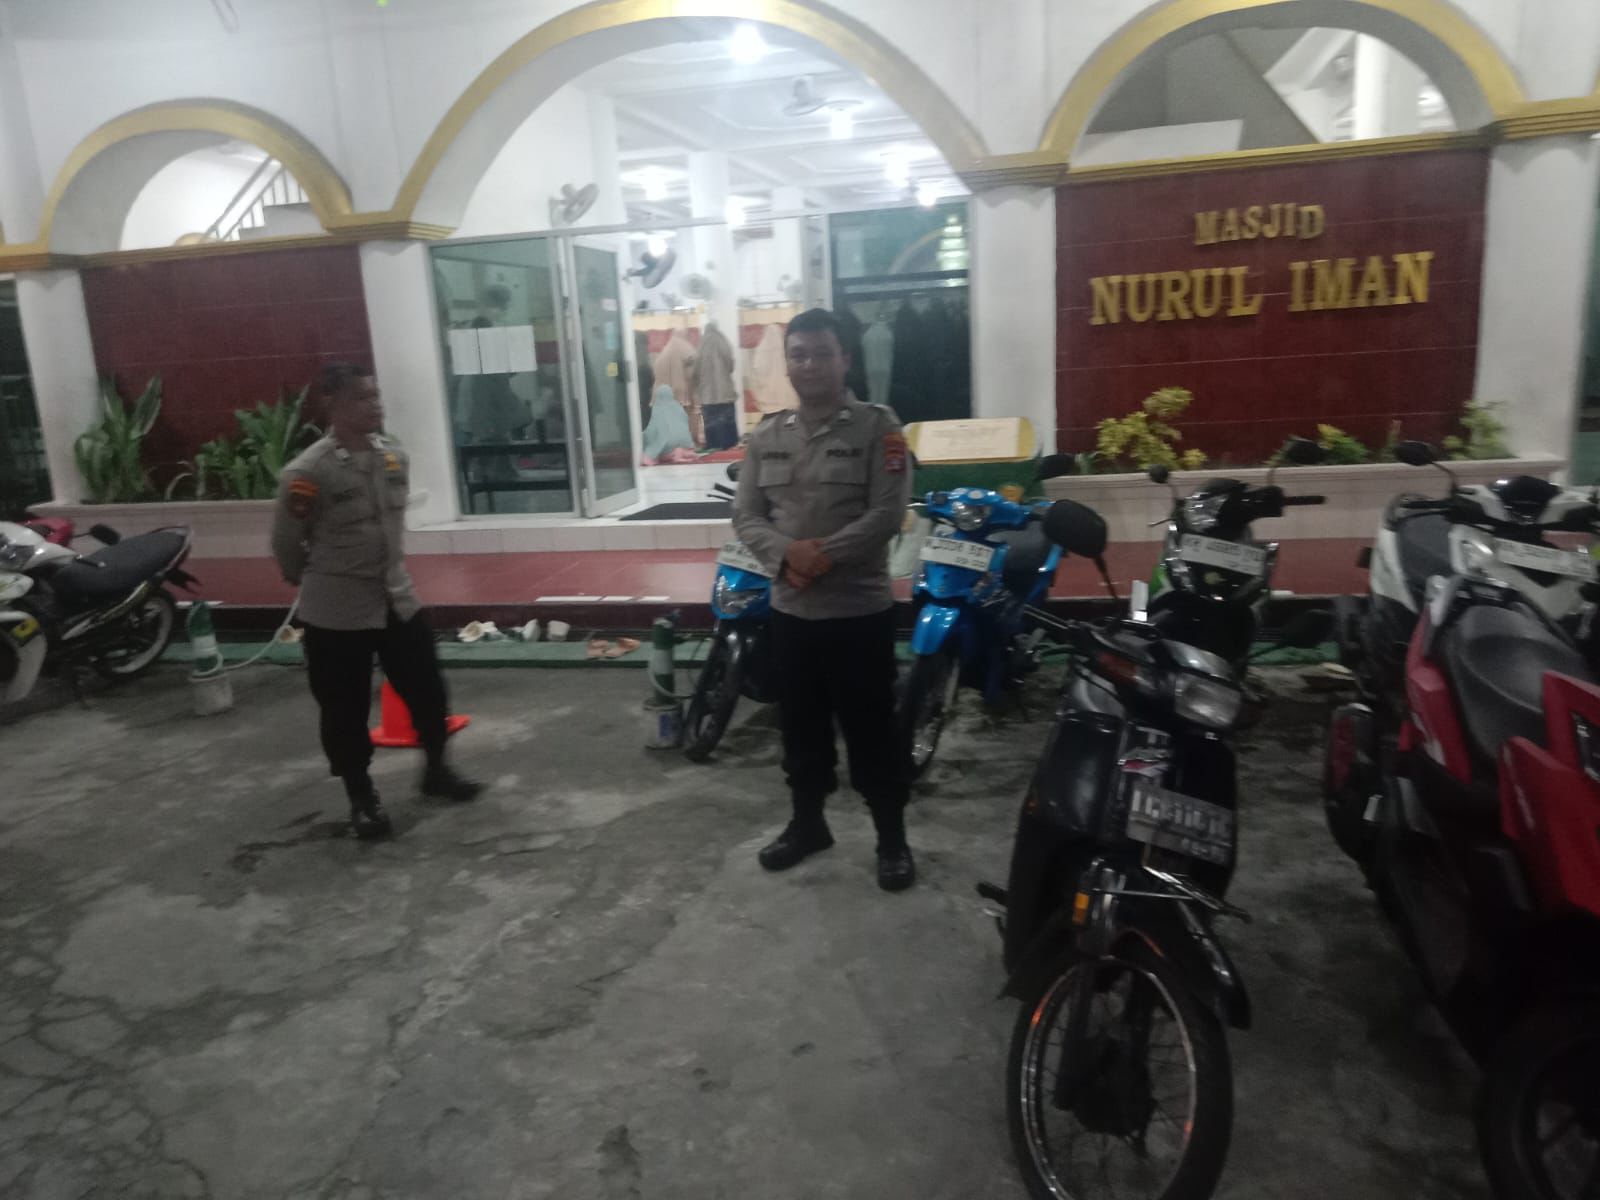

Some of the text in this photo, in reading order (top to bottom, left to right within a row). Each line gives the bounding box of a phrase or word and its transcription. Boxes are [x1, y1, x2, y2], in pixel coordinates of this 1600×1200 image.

[1194, 203, 1326, 246] MASJID
[1089, 251, 1434, 326] NURUL IMAN
